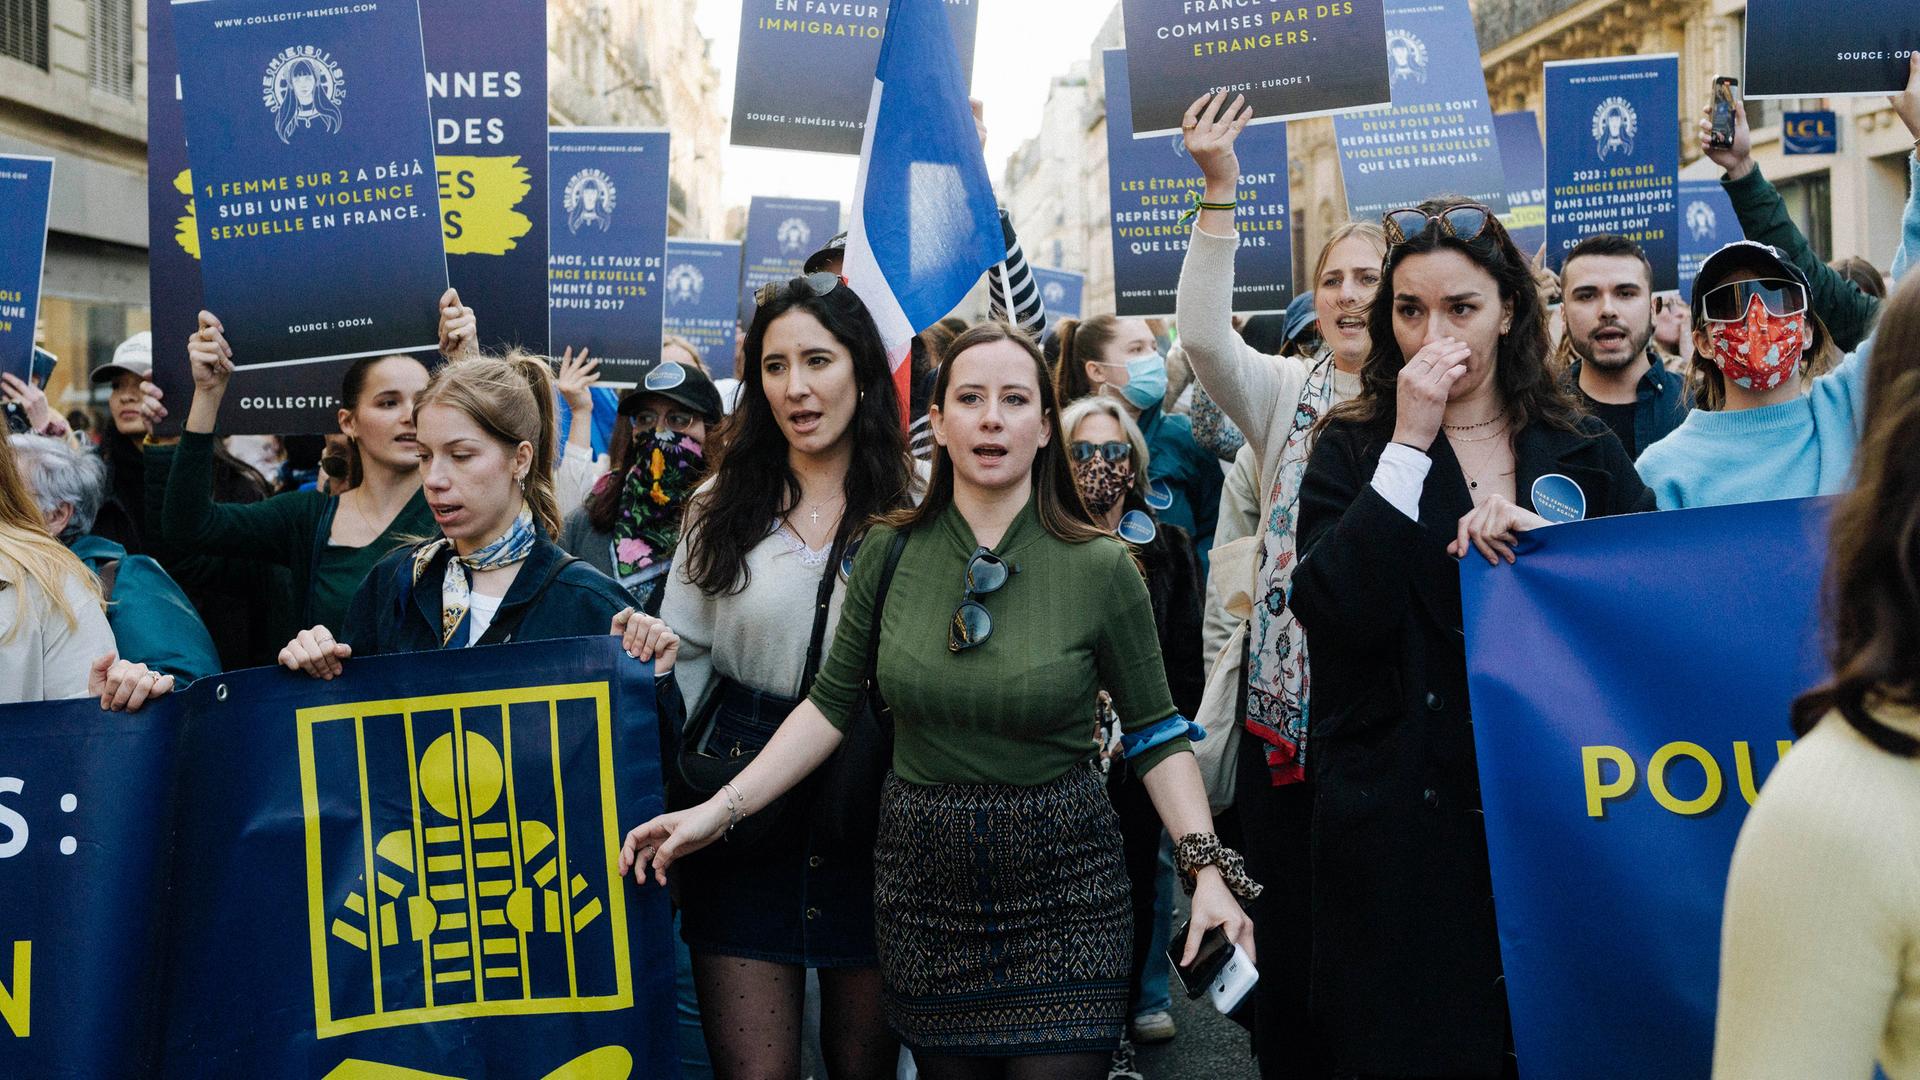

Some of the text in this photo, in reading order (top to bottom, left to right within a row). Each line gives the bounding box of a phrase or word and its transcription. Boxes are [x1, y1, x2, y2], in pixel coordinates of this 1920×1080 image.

[214, 3, 377, 29] WWW.COLLECTIF-NEMESIS.COM
[775, 0, 798, 11] EN
[806, 1, 879, 18] FAVEUR
[759, 17, 885, 39] IMMIGRATIO
[1157, 2, 1353, 40] COMMISES PAR DES
[1193, 29, 1317, 57] ETRANGERS.
[1837, 51, 1883, 61] SOURCE
[426, 71, 522, 98] NNES
[1209, 82, 1251, 95] SOURCE
[1262, 76, 1301, 88] EUROPE
[1305, 75, 1311, 84] 1
[1446, 100, 1478, 111] SONT
[746, 112, 785, 122] SOURCE
[794, 116, 835, 127] NÉMÉSIS
[839, 121, 855, 129] VIA
[1362, 114, 1465, 131] DEUX FOIS PLUS
[1786, 119, 1831, 138] LCL
[437, 118, 504, 144] DES
[1342, 124, 1490, 147] REPRÉSENTÉS DANS LES
[1345, 137, 1491, 159] VIOLENCES SEXUELLES
[1358, 152, 1483, 174] QUE LES FRANÇAIS.
[205, 159, 423, 198] 1 FEMME SUR 2 A DÉJÀ
[1573, 170, 1600, 181] 2023
[1635, 164, 1654, 175] DES
[437, 170, 475, 199] ES
[1121, 173, 1276, 192] LES ÉTRANG SONT
[1554, 182, 1614, 196] VIOLENCES
[1617, 176, 1673, 190] SEXUELLES
[219, 184, 414, 218] SUBI UNE VIOLENCE
[1141, 194, 1179, 206] DEUX
[1555, 200, 1582, 210] DANS
[1586, 196, 1604, 207] LES
[1606, 189, 1673, 204] TRANSPORTS
[1116, 204, 1284, 222] REPRÉSEN NS LES
[1551, 213, 1565, 223] EN
[1568, 208, 1617, 222] COMMUN
[1621, 206, 1634, 216] EN
[211, 205, 427, 240] SEXUELLE EN FRANCE.
[444, 210, 463, 239] S
[1578, 218, 1650, 234] FRANCE SONT
[1645, 229, 1665, 240] DES
[1131, 237, 1271, 254] QUE LES AIS.
[590, 256, 604, 266] LE
[609, 256, 641, 267] TAUX
[645, 257, 661, 267] DE
[584, 270, 643, 282] SEXUELLE
[647, 272, 656, 282] A
[549, 282, 647, 296] MENTÉ DE 112%
[1276, 284, 1286, 292] ET
[594, 299, 625, 310] 2017
[288, 322, 328, 334] SOURCE
[338, 317, 374, 329] ODOXA
[240, 396, 341, 410] COLLECTIF-
